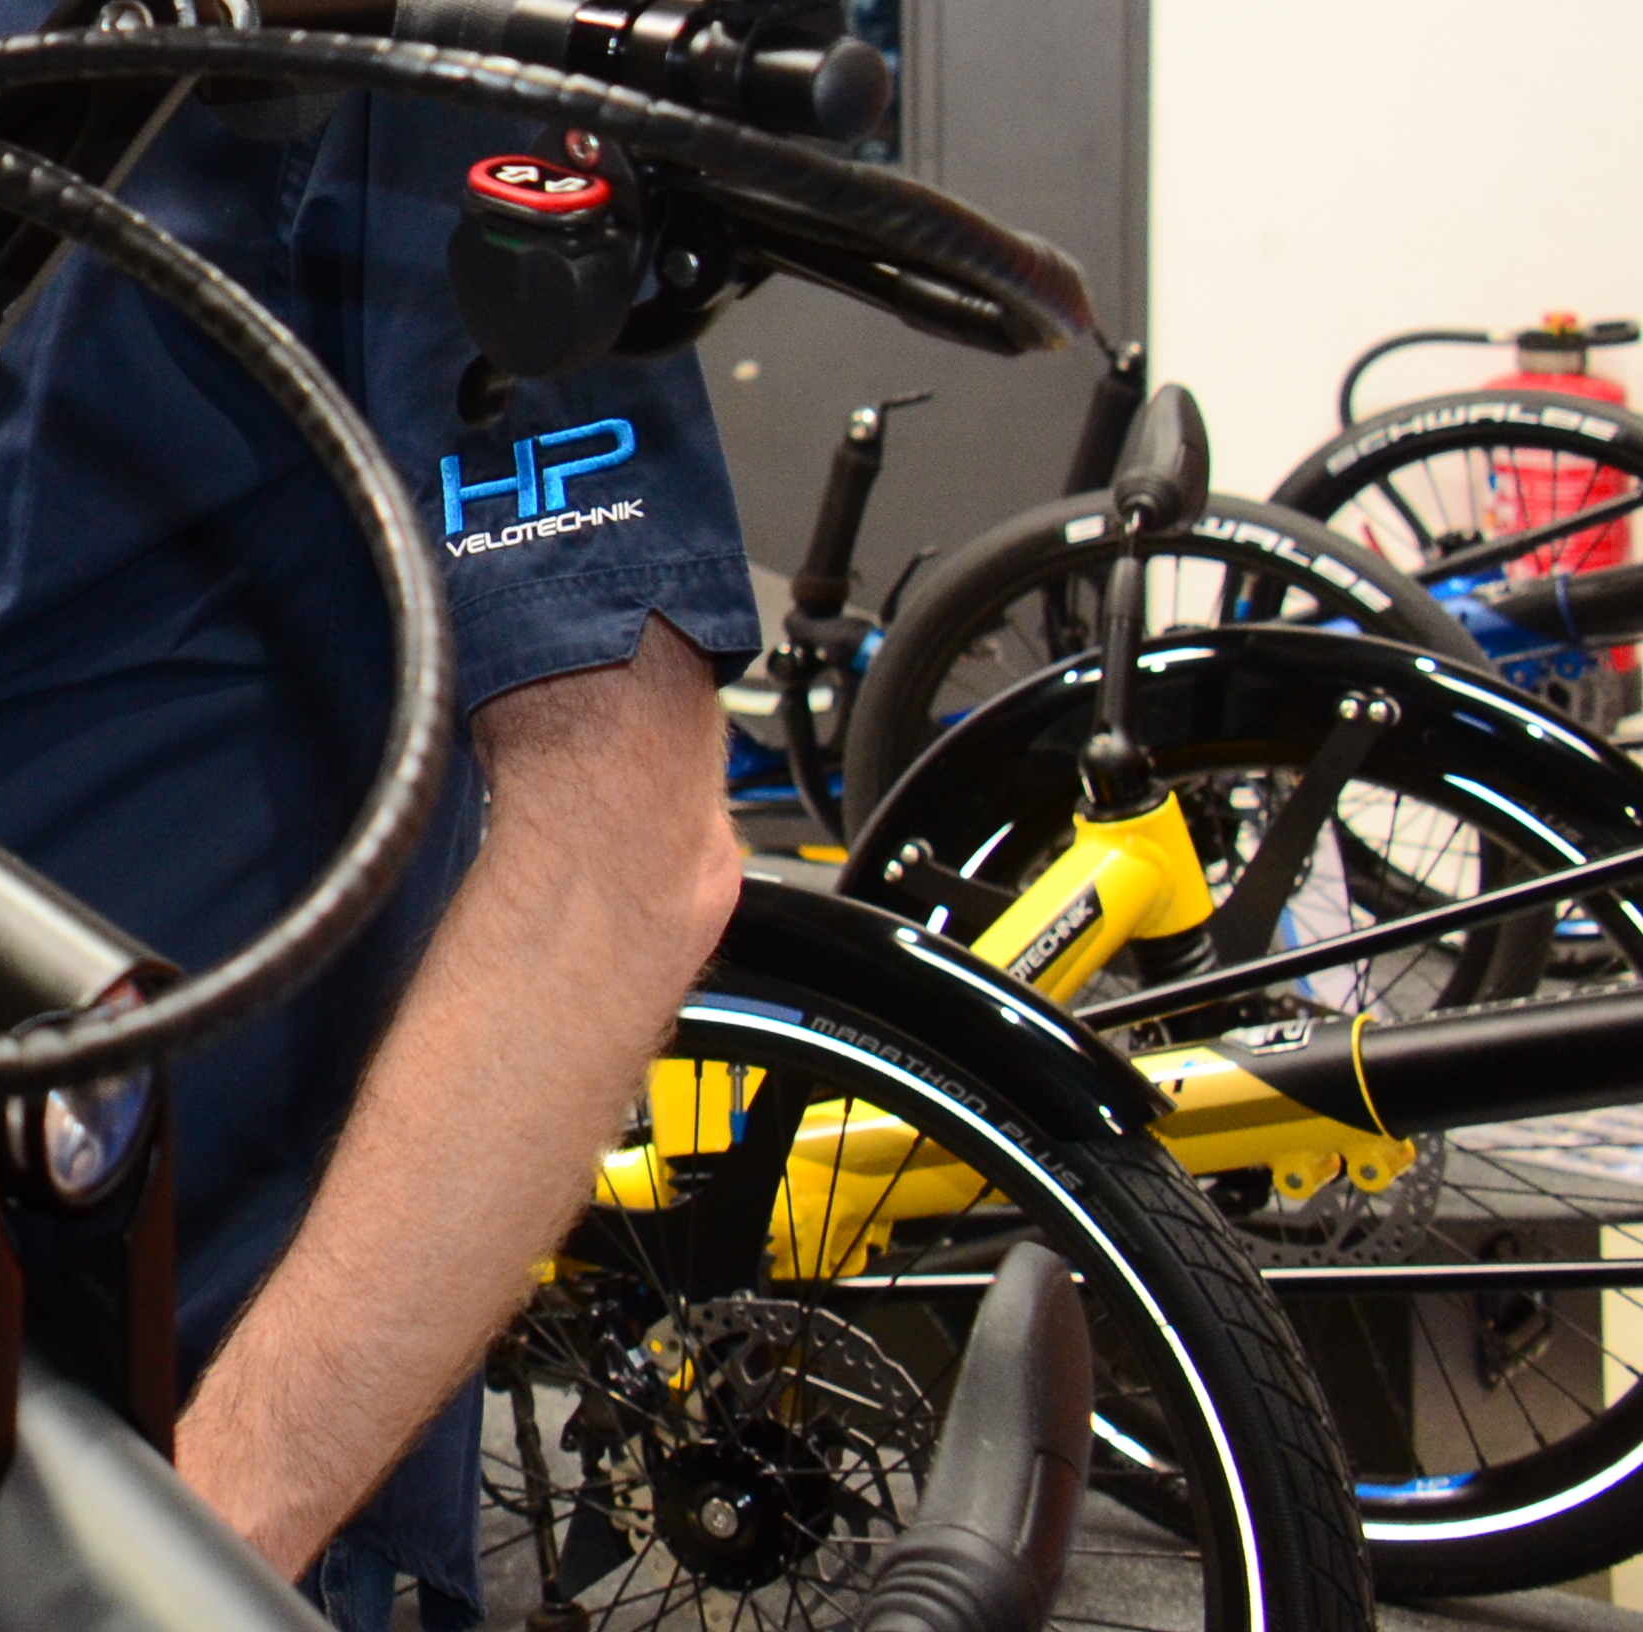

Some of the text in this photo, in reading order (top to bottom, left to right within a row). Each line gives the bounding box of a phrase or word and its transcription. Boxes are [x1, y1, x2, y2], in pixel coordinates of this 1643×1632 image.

[440, 418, 636, 536] HP
[1326, 402, 1619, 477] SCHWALBE
[445, 498, 645, 558] VELOTECHNIK
[1065, 515, 1393, 613] SWALBE
[810, 1015, 1084, 1192] MARATHON PLUS
